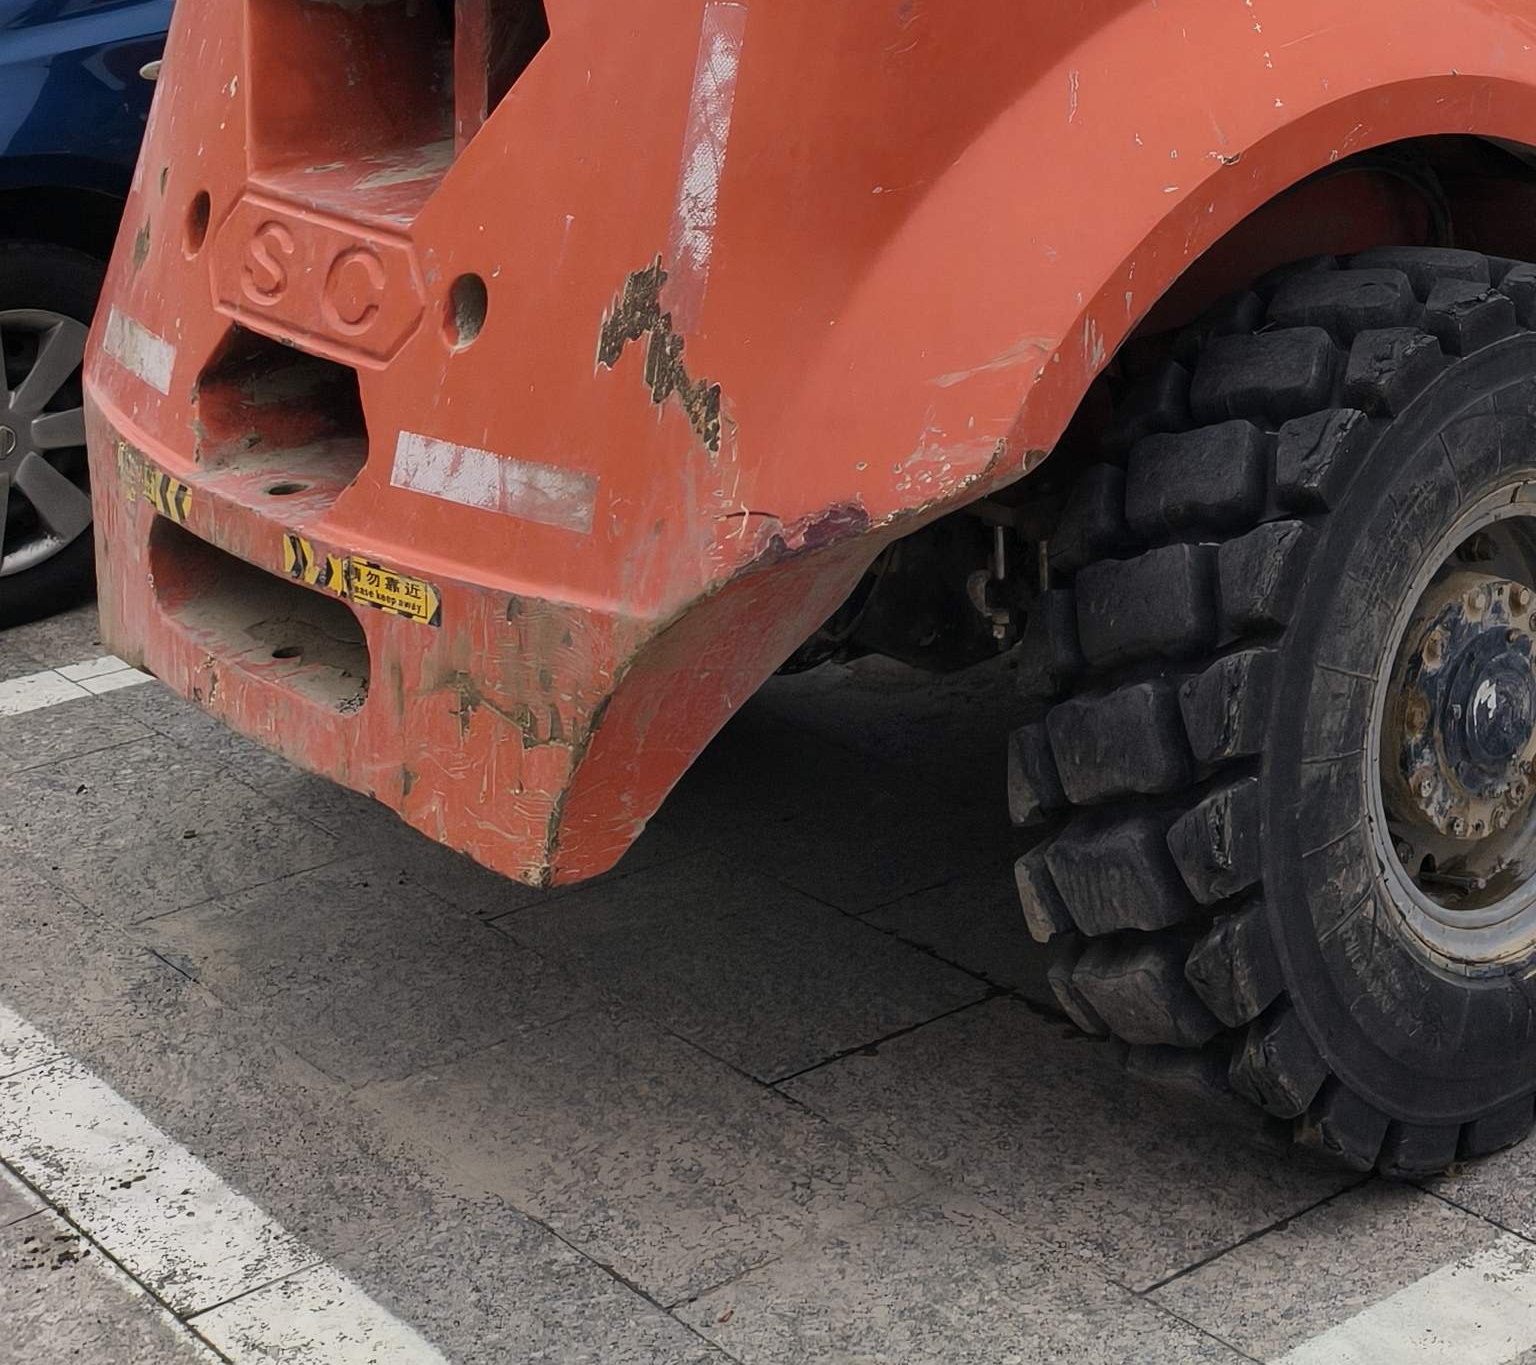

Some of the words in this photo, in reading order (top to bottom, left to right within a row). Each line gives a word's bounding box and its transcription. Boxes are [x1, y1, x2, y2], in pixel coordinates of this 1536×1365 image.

[353, 585, 374, 598] ease
[376, 591, 397, 606] keep
[398, 599, 422, 615] away
